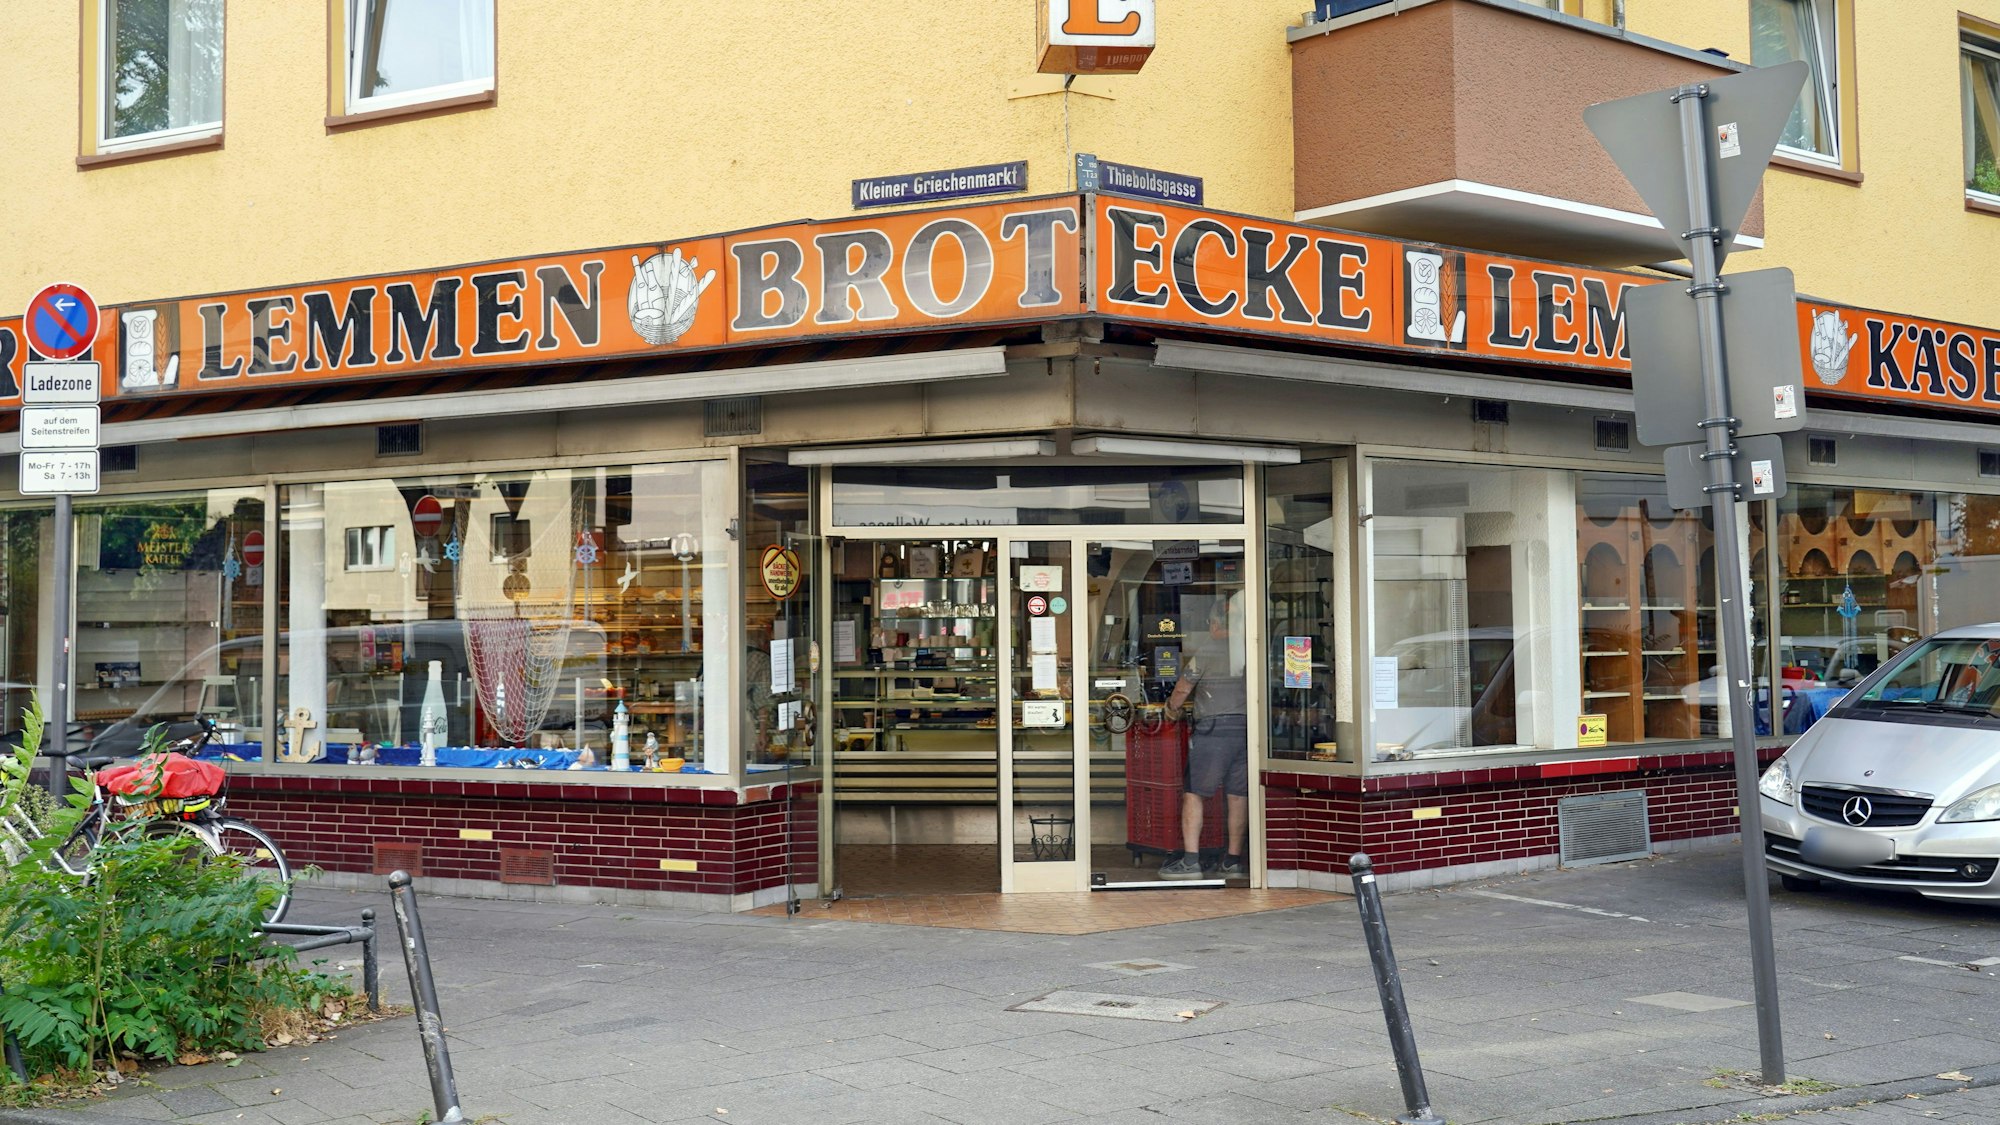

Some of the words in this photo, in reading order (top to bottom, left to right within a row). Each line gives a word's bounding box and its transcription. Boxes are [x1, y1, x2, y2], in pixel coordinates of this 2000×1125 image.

[1077, 158, 1084, 167] S
[859, 181, 908, 200] Kleiner
[913, 165, 1018, 194] Griechenmarkt
[1106, 165, 1196, 198] Thieboldsgasse
[730, 206, 1078, 332] BROT
[1106, 205, 1372, 332] ECKE
[197, 259, 605, 381] LEMMEN
[31, 375, 92, 391] Ladezone
[43, 416, 57, 425] auf
[59, 416, 78, 425] dem
[31, 427, 90, 436] Seitenstreifen
[28, 462, 55, 470] Mo-Fr
[60, 462, 66, 470] 7
[74, 462, 91, 470] 17h
[44, 472, 55, 480] Sa
[60, 472, 66, 480] 7
[74, 472, 91, 480] 13h
